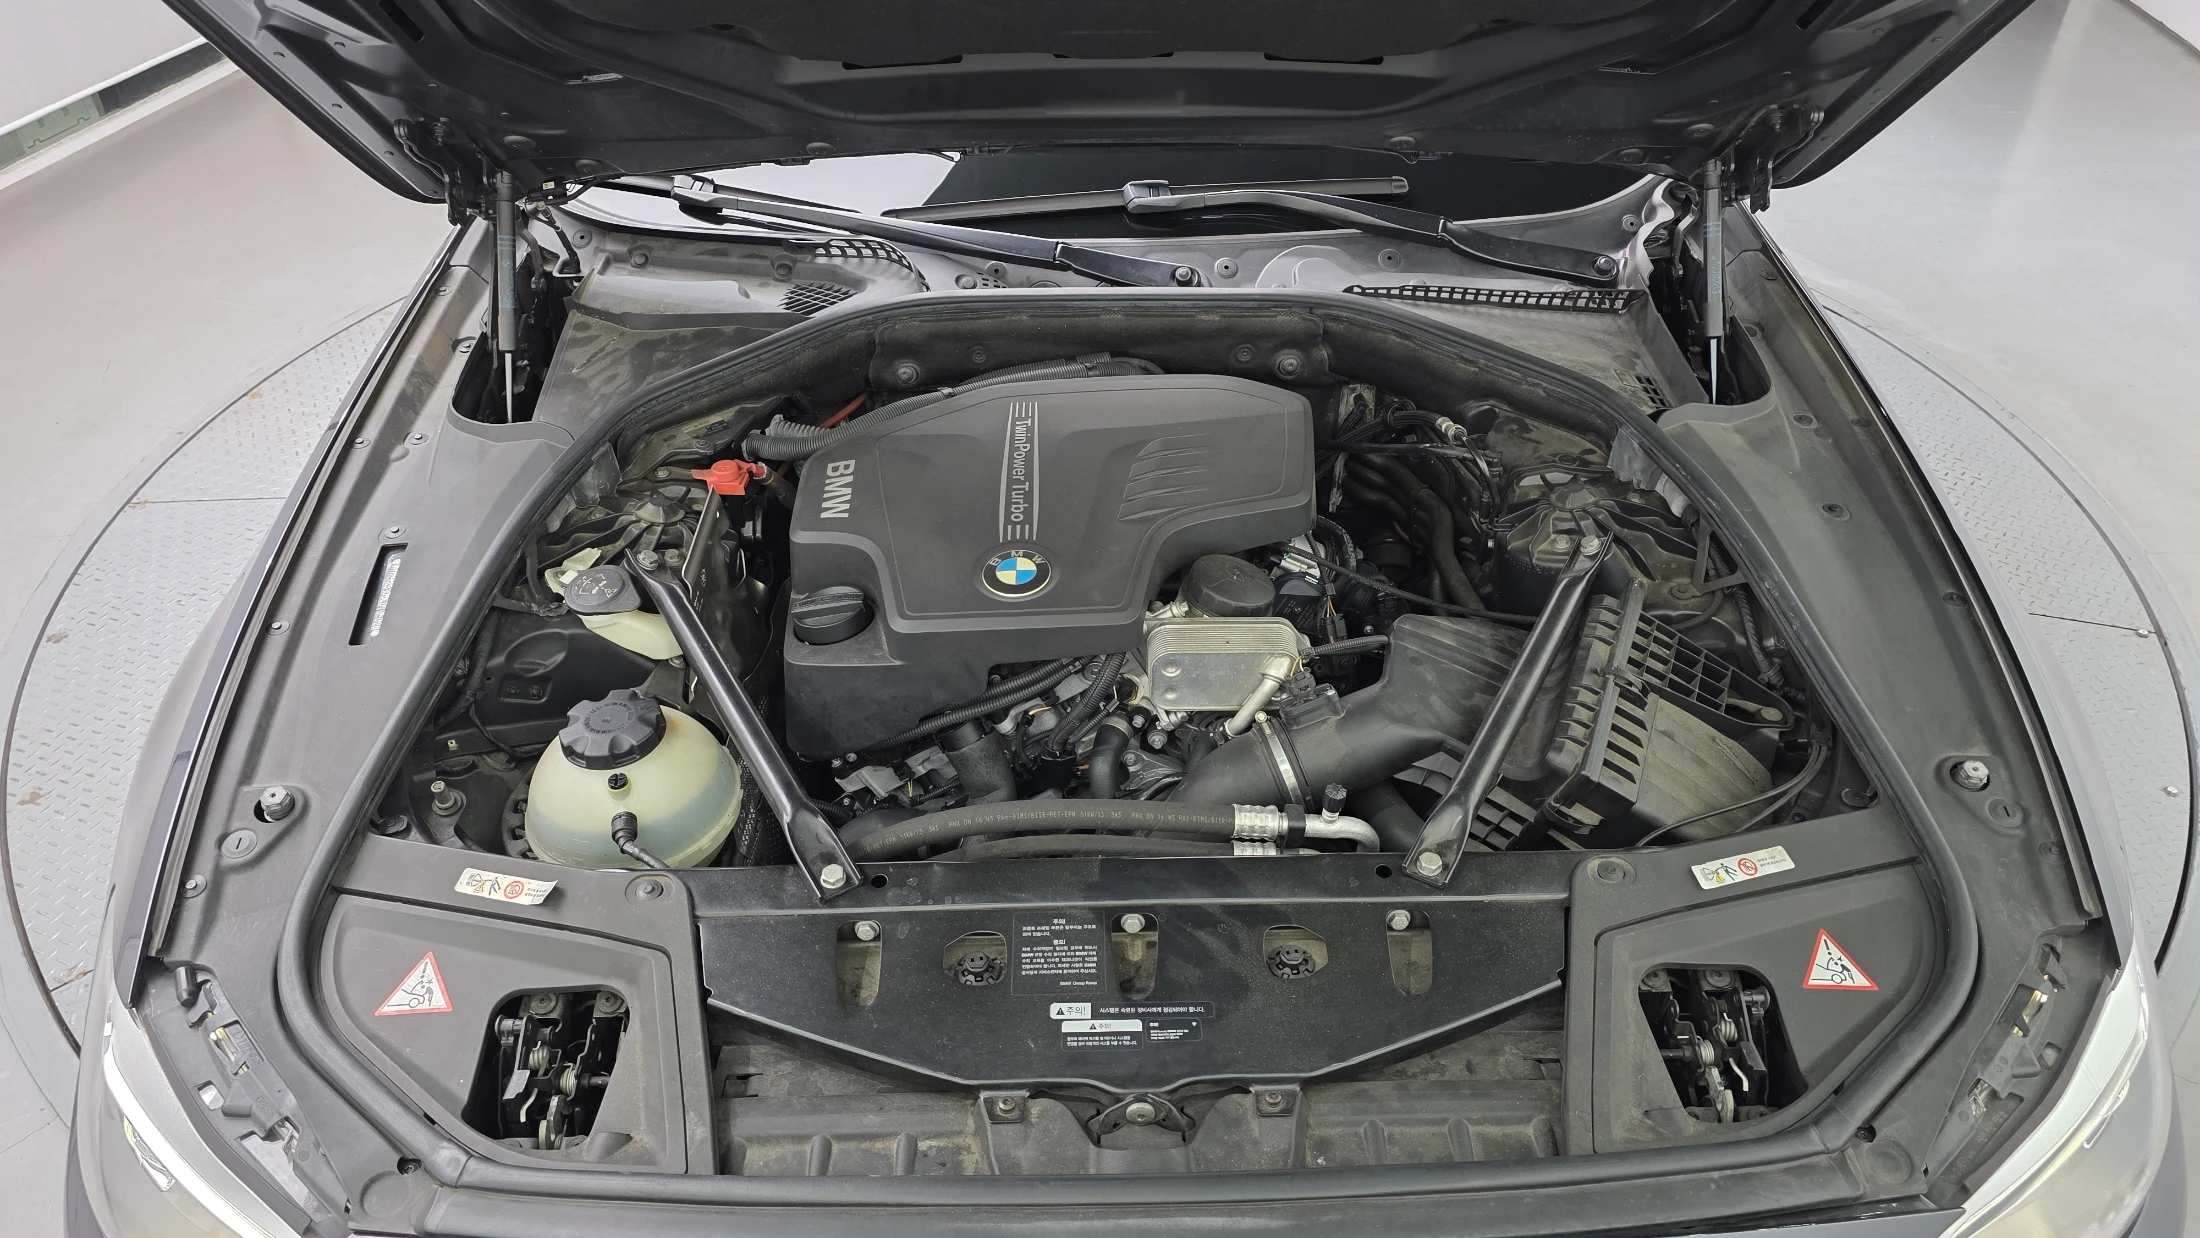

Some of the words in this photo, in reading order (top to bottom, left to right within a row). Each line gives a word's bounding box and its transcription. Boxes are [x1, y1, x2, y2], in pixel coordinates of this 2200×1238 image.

[1013, 418, 1031, 480] TwinPower
[820, 460, 856, 518] BMW
[1010, 482, 1029, 522] Turbo
[989, 550, 1045, 566] BMW
[1066, 1006, 1086, 1015] 주의!
